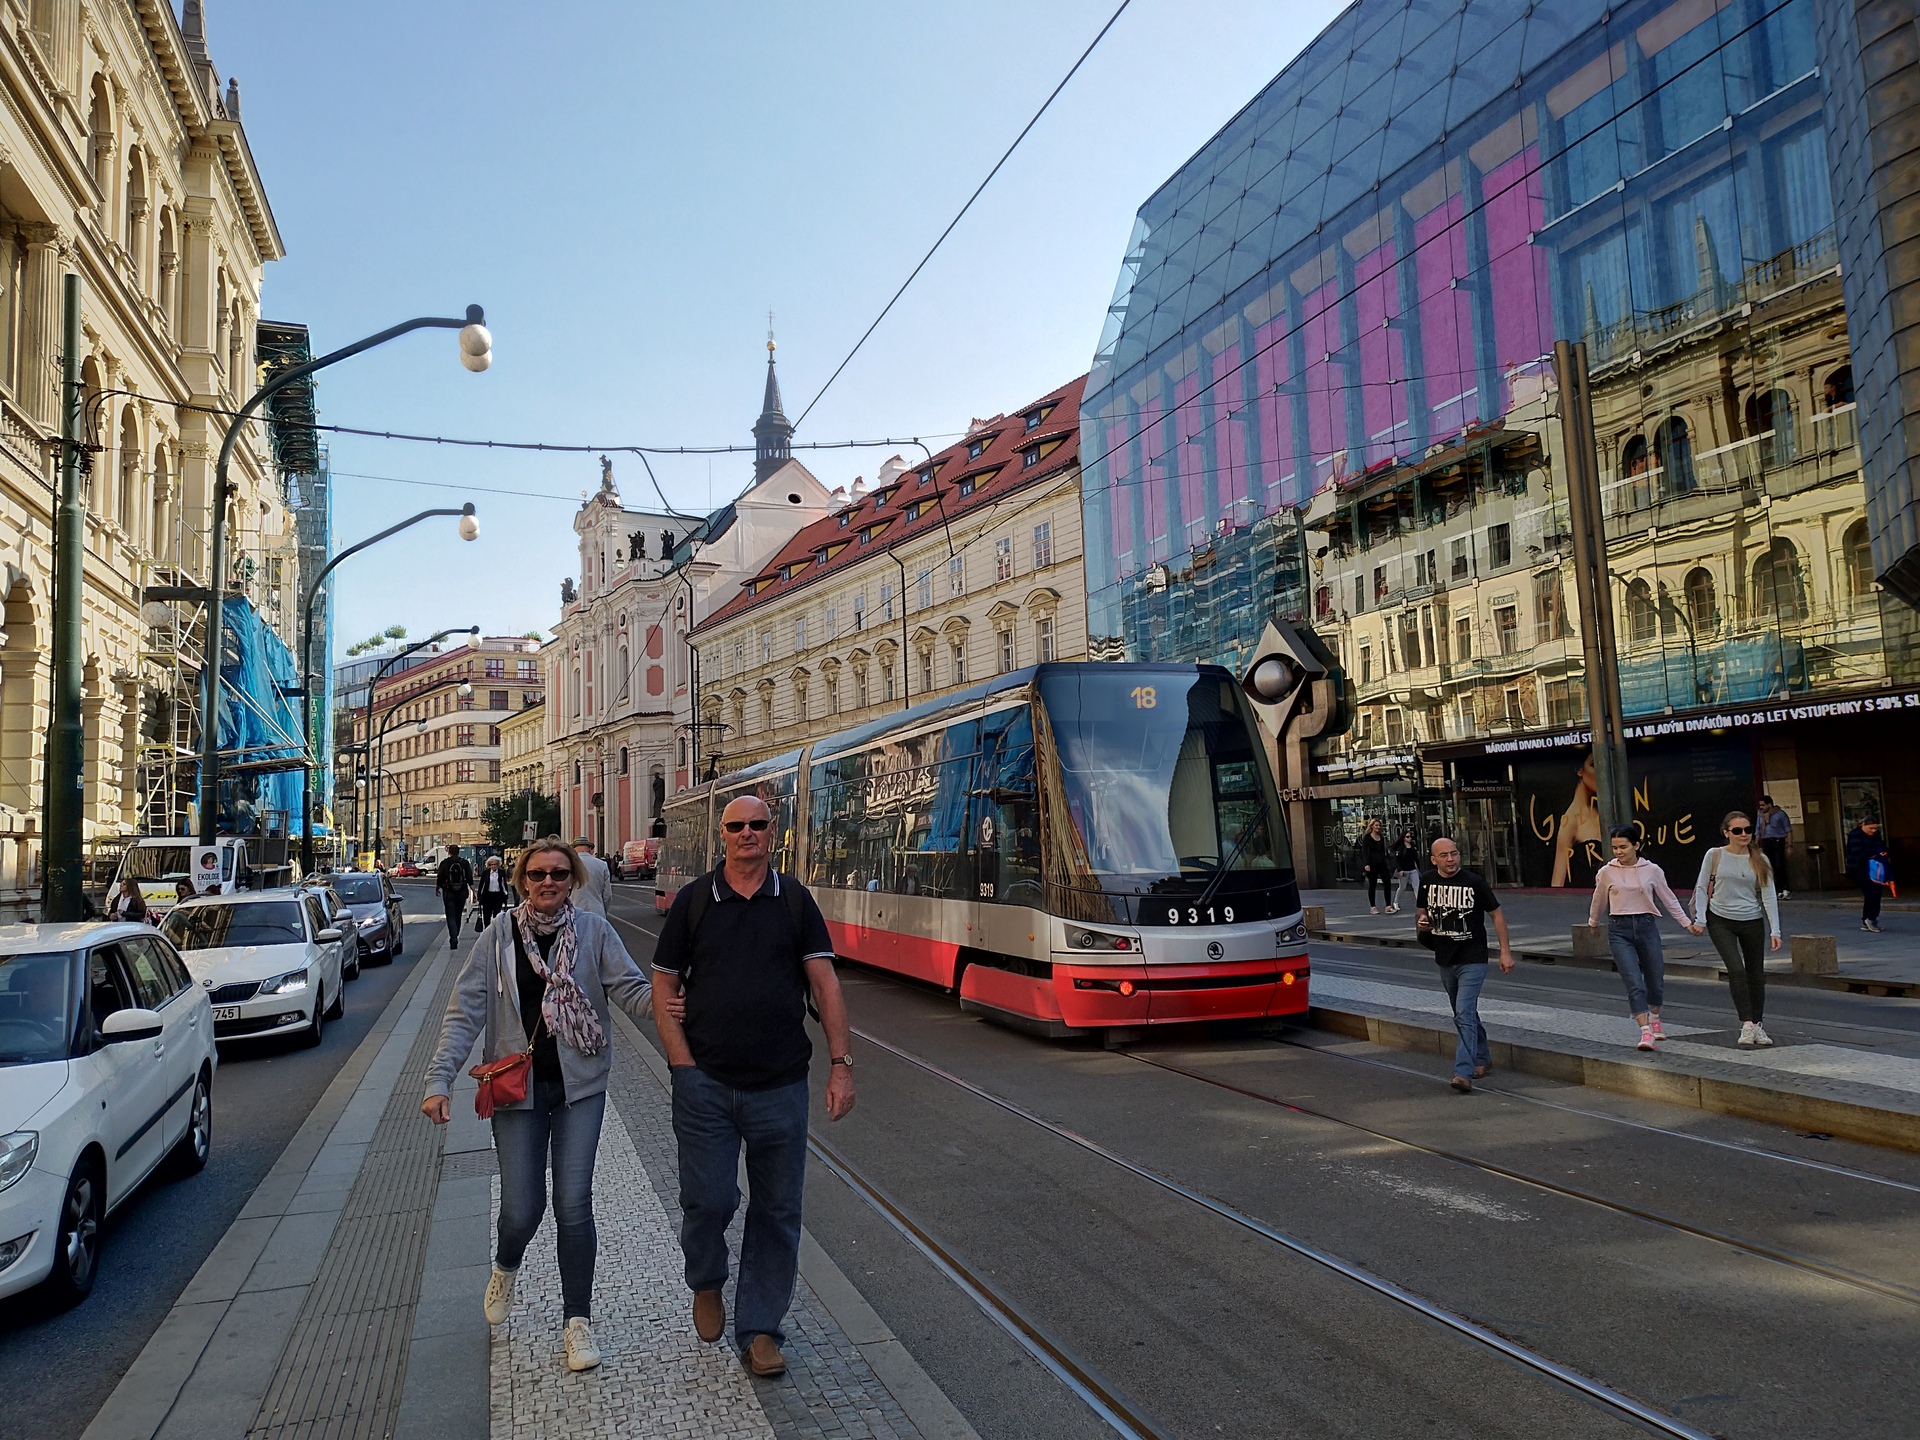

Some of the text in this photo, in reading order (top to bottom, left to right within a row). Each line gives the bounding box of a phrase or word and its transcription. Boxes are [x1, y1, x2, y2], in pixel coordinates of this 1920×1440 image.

[1130, 686, 1156, 709] 18
[1485, 740, 1519, 754] NÁRODNÍ
[1519, 738, 1553, 750] DIVADLO
[1554, 732, 1581, 747] NABÍZÍ
[1635, 726, 1643, 737] A
[1643, 721, 1685, 736] MLADÝM
[1685, 715, 1732, 732] DIVÁKŮM
[1734, 714, 1750, 726] DO
[1751, 712, 1765, 724] 26
[1766, 709, 1788, 722] LET
[1789, 700, 1862, 720] VSTUPENKY
[1864, 699, 1875, 711] S
[980, 883, 994, 897] 9319
[1437, 885, 1475, 909] BEATLES
